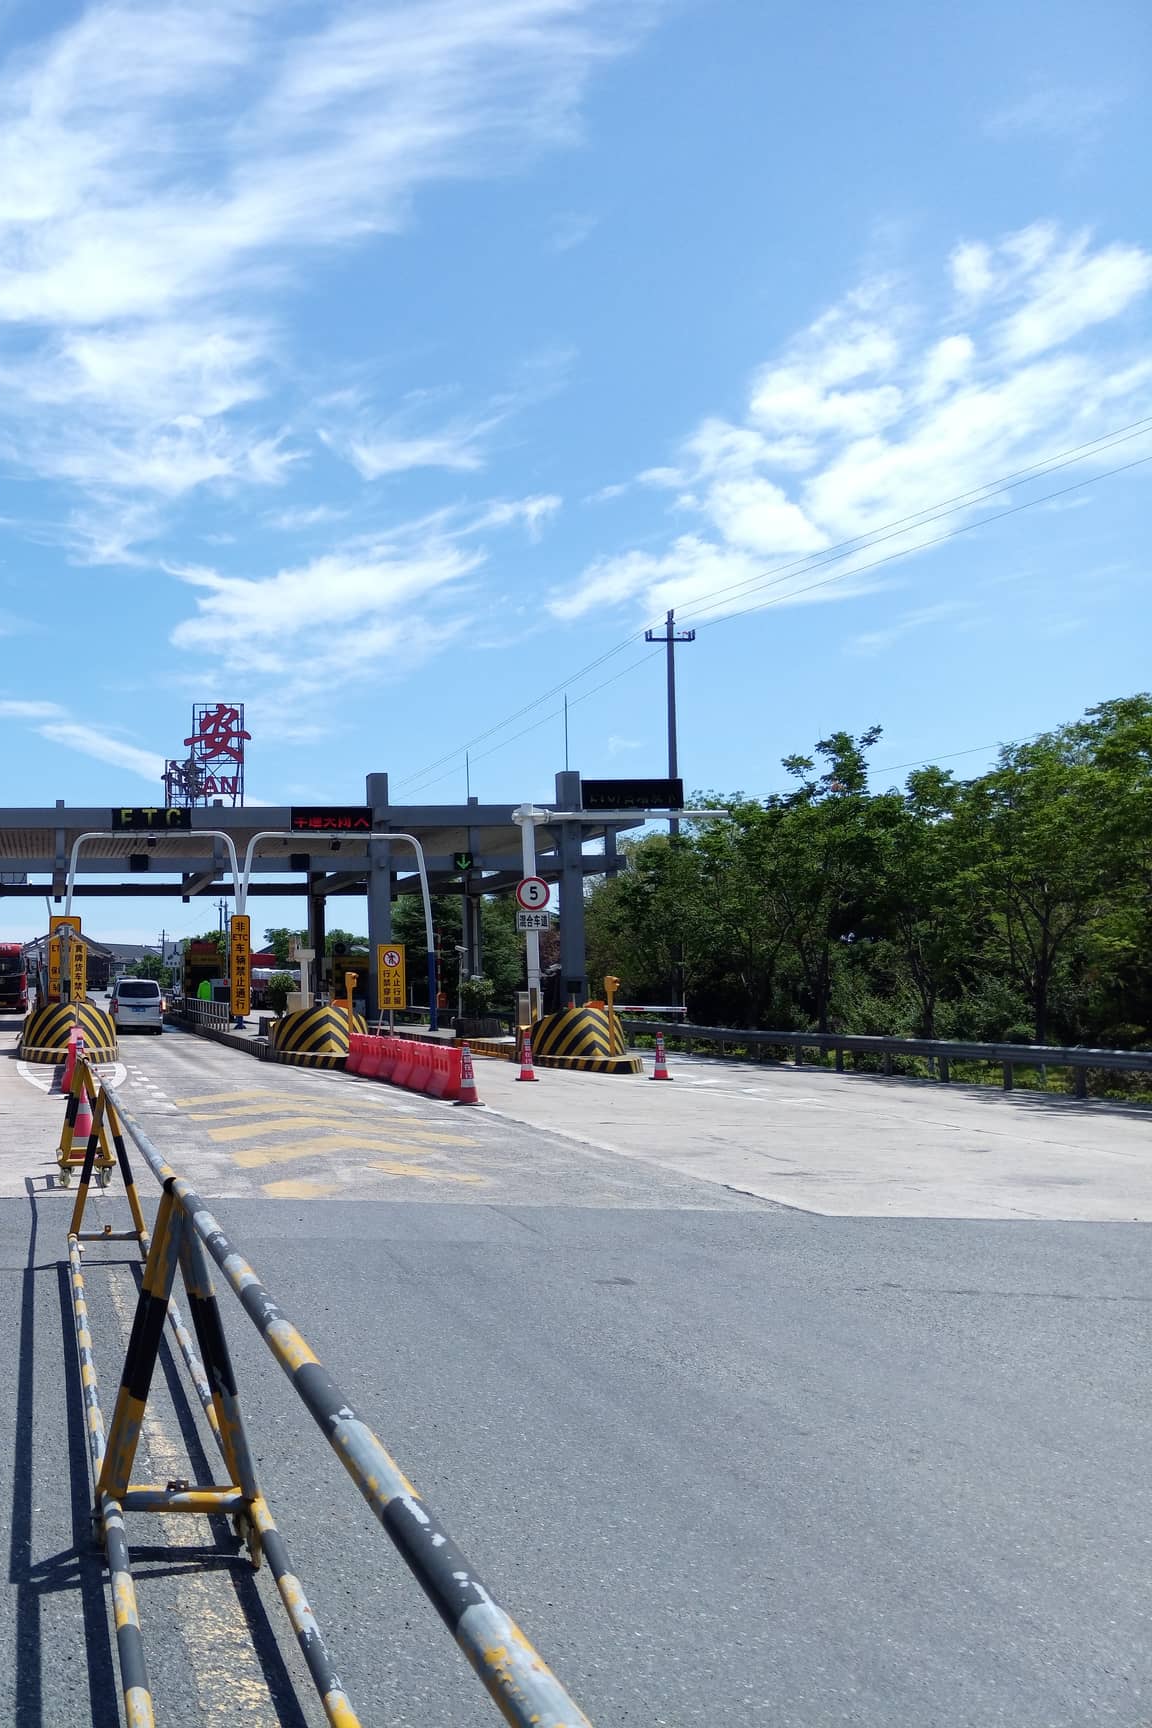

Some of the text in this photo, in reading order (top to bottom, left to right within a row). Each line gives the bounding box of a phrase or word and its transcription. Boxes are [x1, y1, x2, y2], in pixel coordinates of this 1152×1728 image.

[184, 703, 252, 763] 安
[201, 776, 240, 794] AN
[120, 808, 181, 825] ETC
[529, 886, 538, 901] 5
[519, 914, 548, 928] 混合车道
